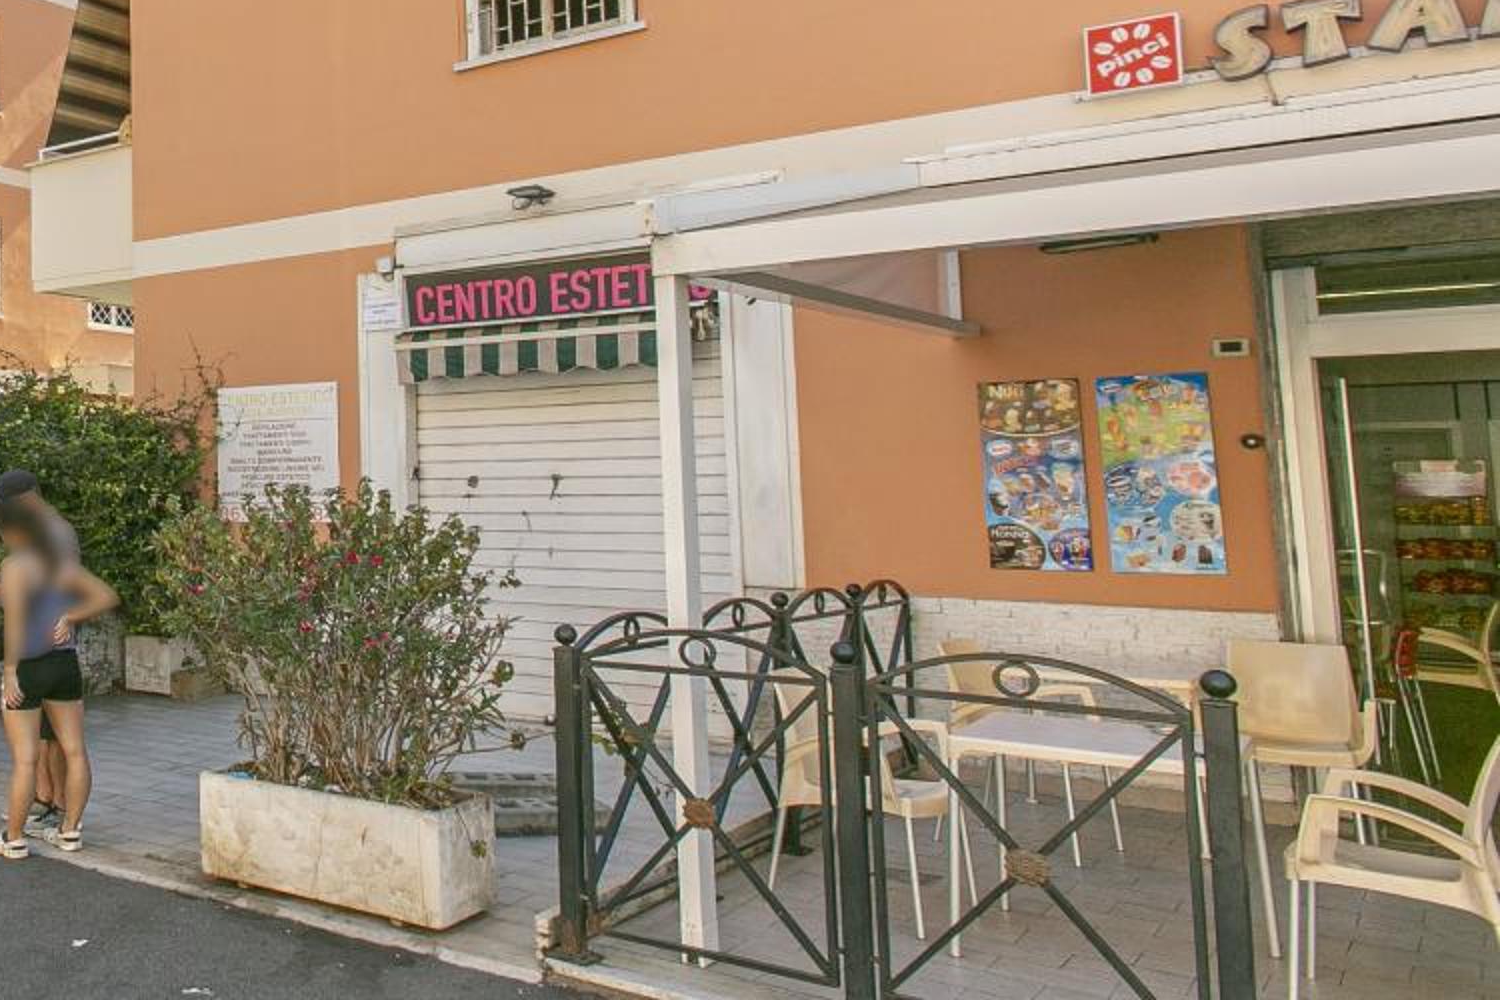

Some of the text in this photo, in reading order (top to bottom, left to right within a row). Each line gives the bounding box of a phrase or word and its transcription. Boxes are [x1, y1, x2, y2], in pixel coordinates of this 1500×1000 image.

[1096, 31, 1170, 78] pinci
[414, 275, 538, 325] CENTRO
[549, 262, 712, 314] ESTET
